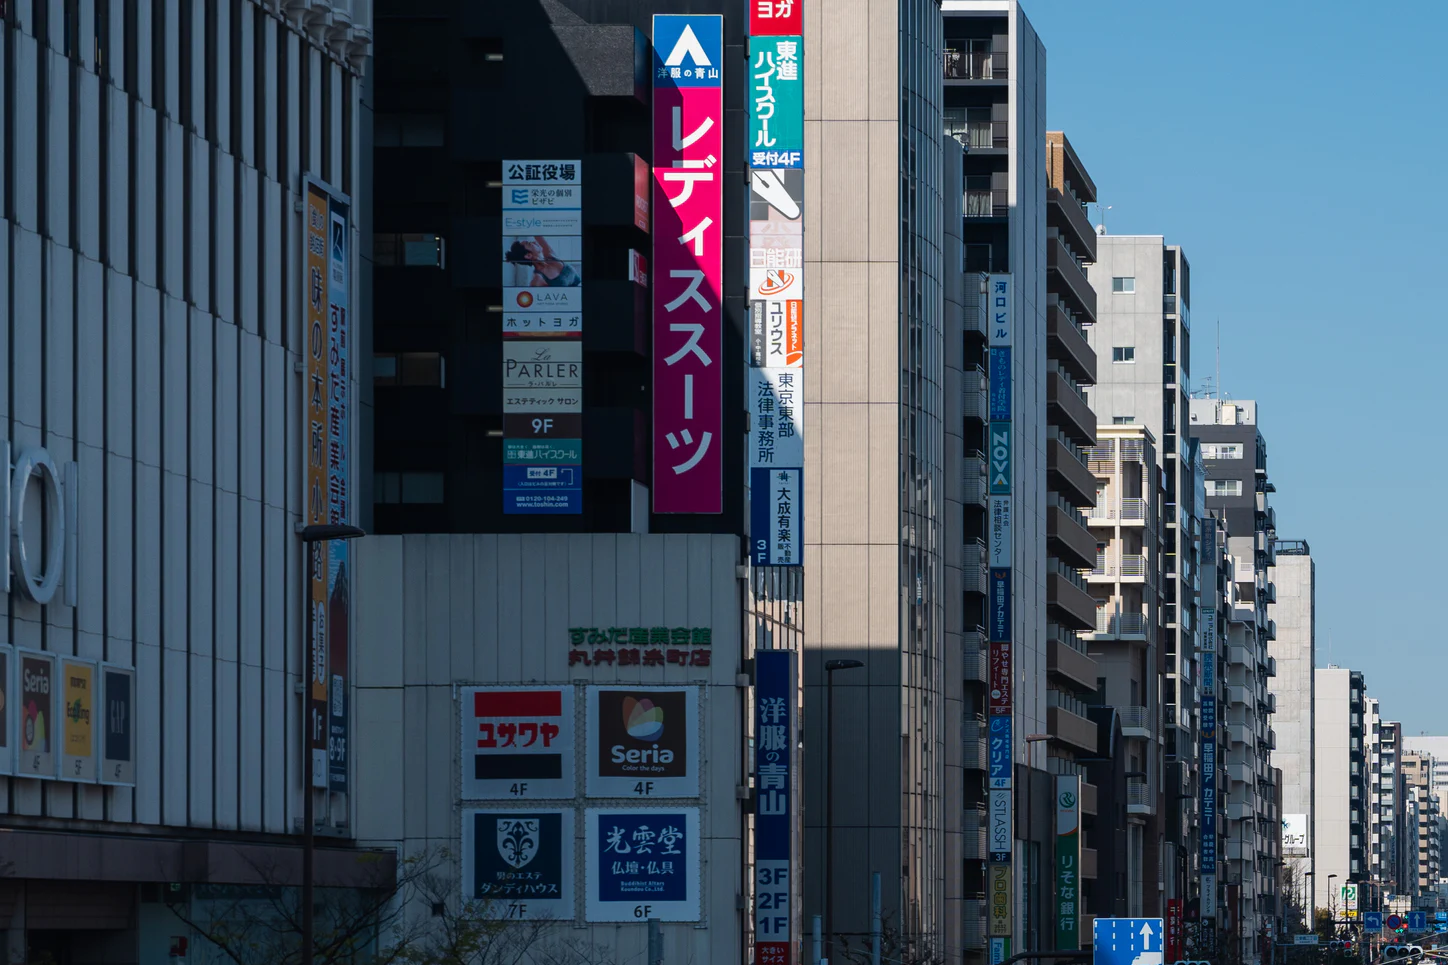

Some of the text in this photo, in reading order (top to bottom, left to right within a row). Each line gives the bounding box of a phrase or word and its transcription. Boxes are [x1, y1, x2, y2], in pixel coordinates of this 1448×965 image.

[758, 1, 795, 18] ヨガ
[776, 41, 798, 80] 東進
[658, 67, 719, 79] 洋服の青山
[754, 52, 776, 147] ハイスクール
[752, 151, 801, 166] 受付4F
[508, 164, 575, 181] 公証役場
[505, 217, 542, 229] E-style
[536, 293, 568, 301] LAVA
[664, 105, 718, 475] レディススーツ
[995, 281, 1007, 339] 河口ビル
[507, 317, 579, 327] ホットヨガ
[770, 302, 784, 355] ユリウス
[506, 359, 579, 378] PARLER
[778, 373, 794, 438] 東京東部
[531, 418, 554, 434] 9F
[758, 381, 774, 463] 法律事務所
[517, 450, 577, 459] 東進ハイスクール
[993, 432, 1007, 486] NOVA
[543, 469, 555, 477] 4F
[777, 488, 791, 543] 大成有楽
[757, 539, 767, 564] 3F
[568, 627, 712, 645] すみだ産業会館
[568, 650, 712, 667] 丸井錦糸町店
[24, 668, 49, 694] Seria
[611, 744, 675, 764] Seria
[758, 697, 788, 816] 洋服の青山
[992, 738, 1003, 776] クリア
[651, 765, 664, 773] days
[510, 783, 528, 796] 4F
[634, 782, 654, 795] 4F
[995, 800, 1006, 850] STLASSH
[604, 825, 684, 856] 光雲堂
[996, 854, 1006, 862] 3F
[611, 862, 675, 875] 仏壇・仏具
[758, 868, 788, 885] 3F
[481, 883, 559, 895] ダンディハウス
[1061, 856, 1074, 930] りそな銀行
[758, 893, 788, 909] 2F
[509, 905, 528, 919] 7F
[634, 906, 652, 919] 6F
[759, 917, 788, 934] 1F
